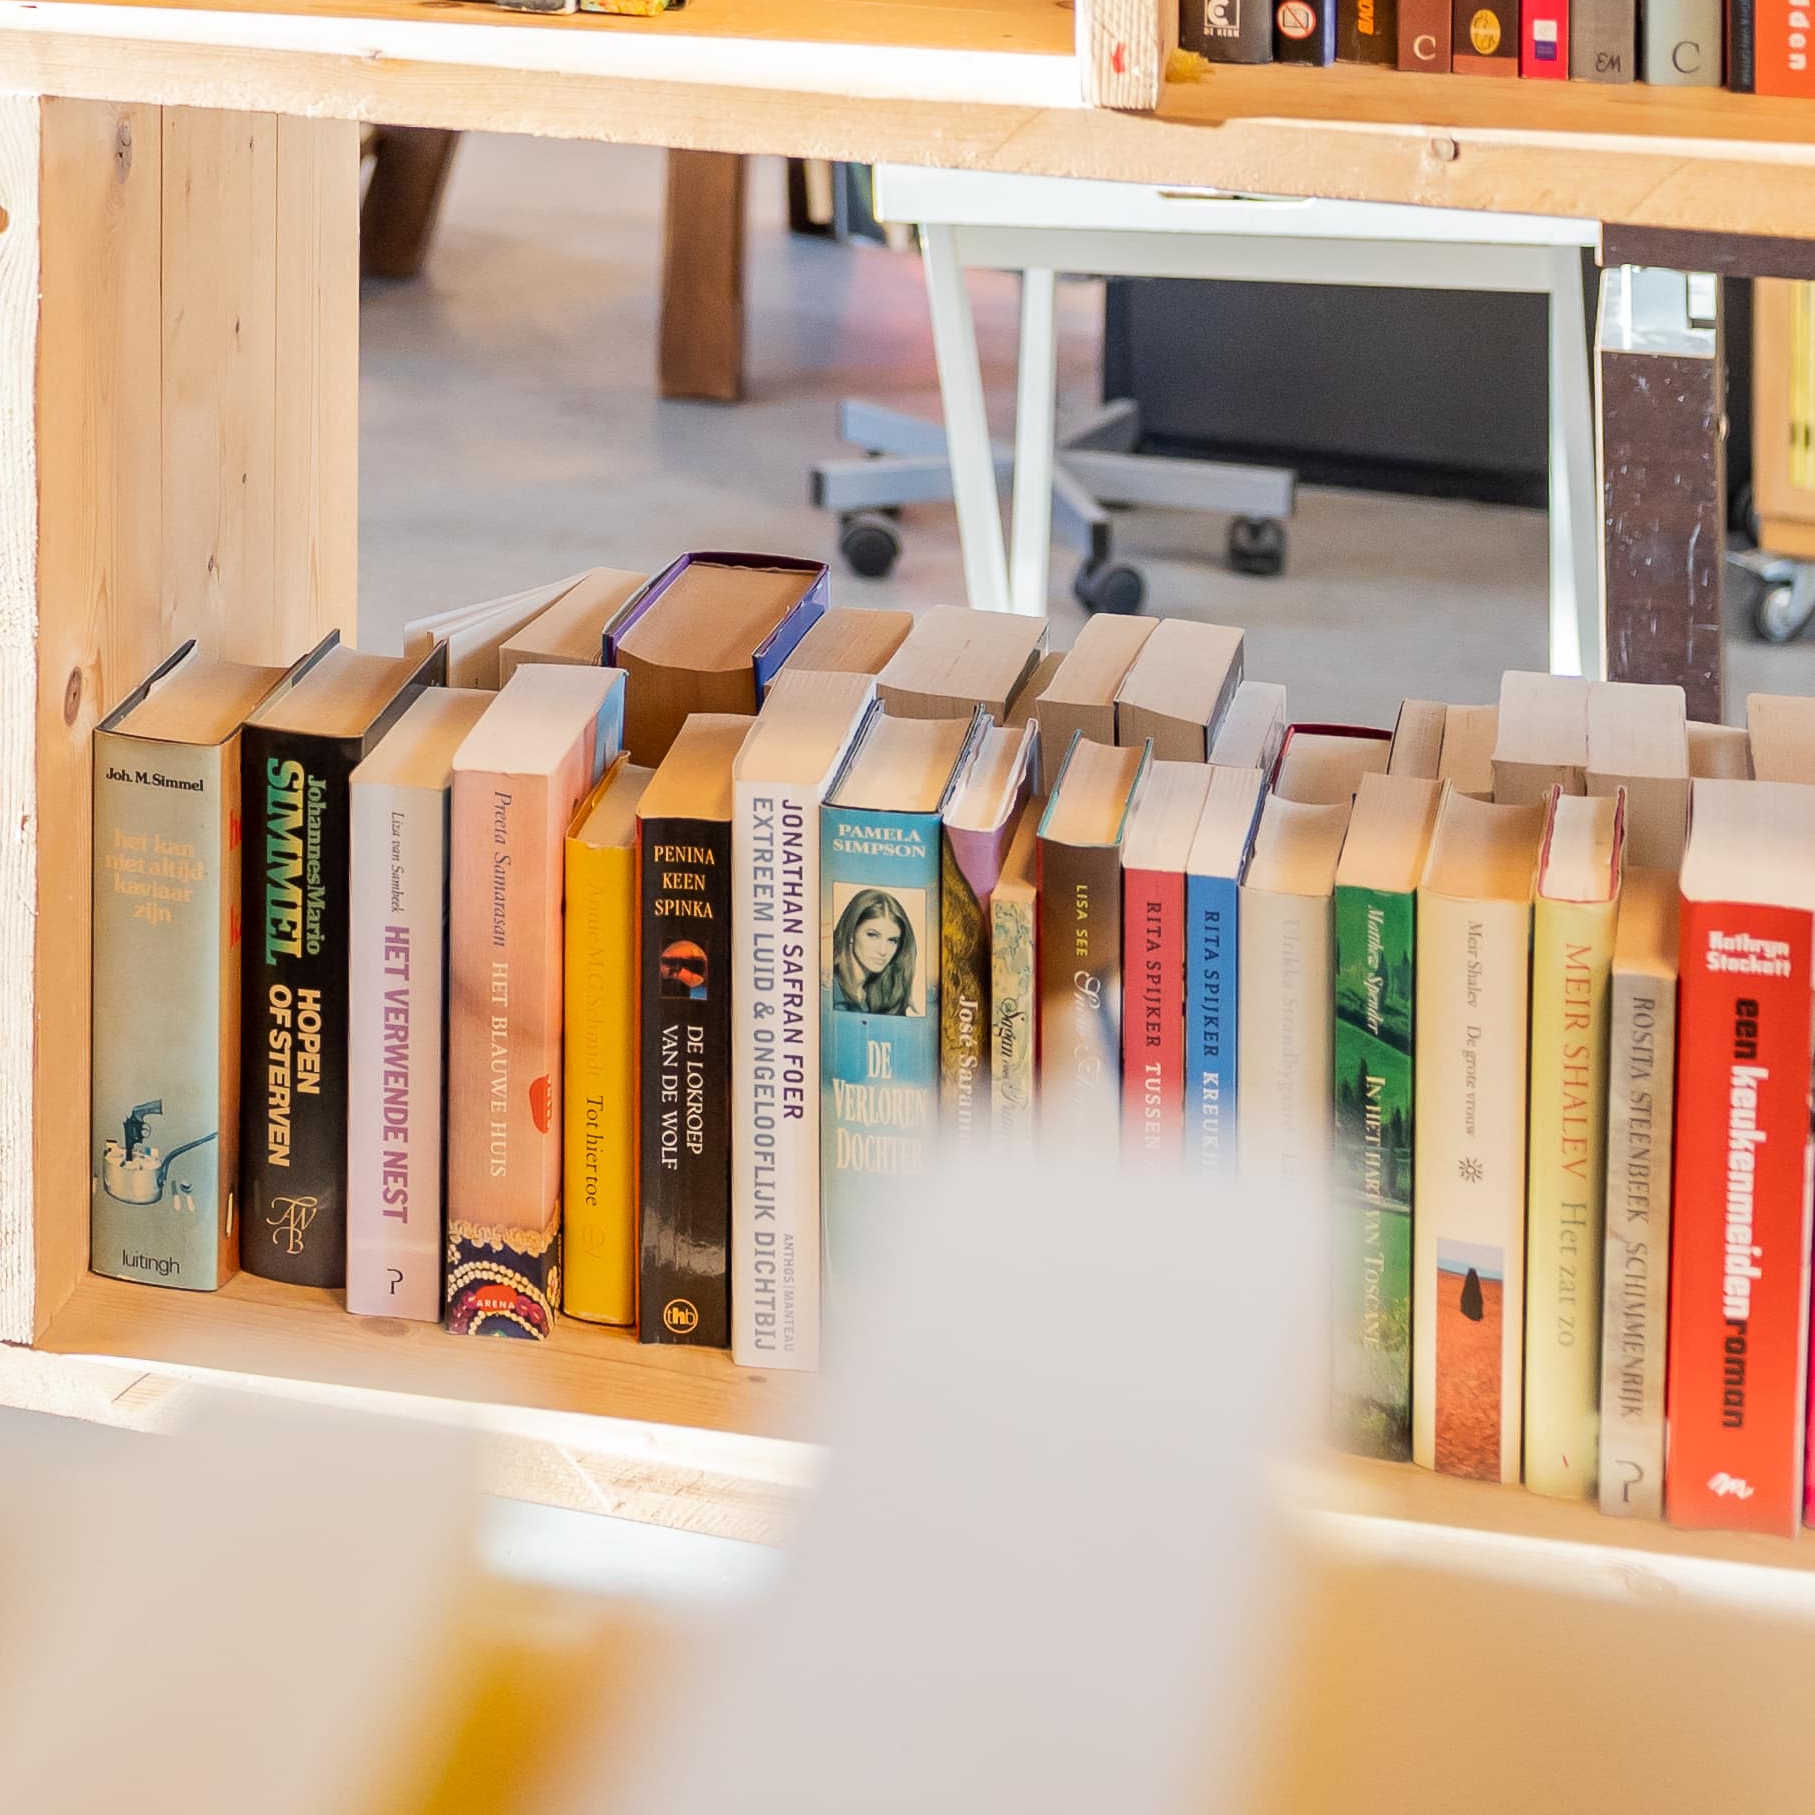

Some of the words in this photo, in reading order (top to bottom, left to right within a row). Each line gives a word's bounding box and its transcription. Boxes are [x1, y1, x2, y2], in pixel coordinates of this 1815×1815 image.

[265, 757, 302, 966] SIMMEL
[305, 775, 326, 884] Johannes
[753, 797, 775, 923] EXTREEM
[782, 798, 804, 934] JONATHAN
[306, 885, 325, 954] Mario
[384, 926, 409, 981] HET
[754, 933, 775, 992] LUID
[783, 944, 804, 1045] SAFRAN
[269, 985, 291, 1030] OF
[297, 989, 320, 1094] HOPEN
[687, 1026, 703, 1054] DE
[753, 1002, 775, 1020] &
[1735, 999, 1762, 1060] een
[383, 989, 409, 1141] VERWENDE
[662, 1026, 678, 1067] VAN
[269, 1031, 291, 1166] STERVEN
[662, 1074, 678, 1103] DE
[686, 1062, 703, 1153] LOKROEP
[782, 1053, 804, 1120] FOER
[661, 1111, 678, 1170] WOLF
[754, 1030, 775, 1221] ONGELOOFLIJK
[382, 1150, 408, 1224] NEST
[753, 1231, 776, 1351] DICHTBIJ
